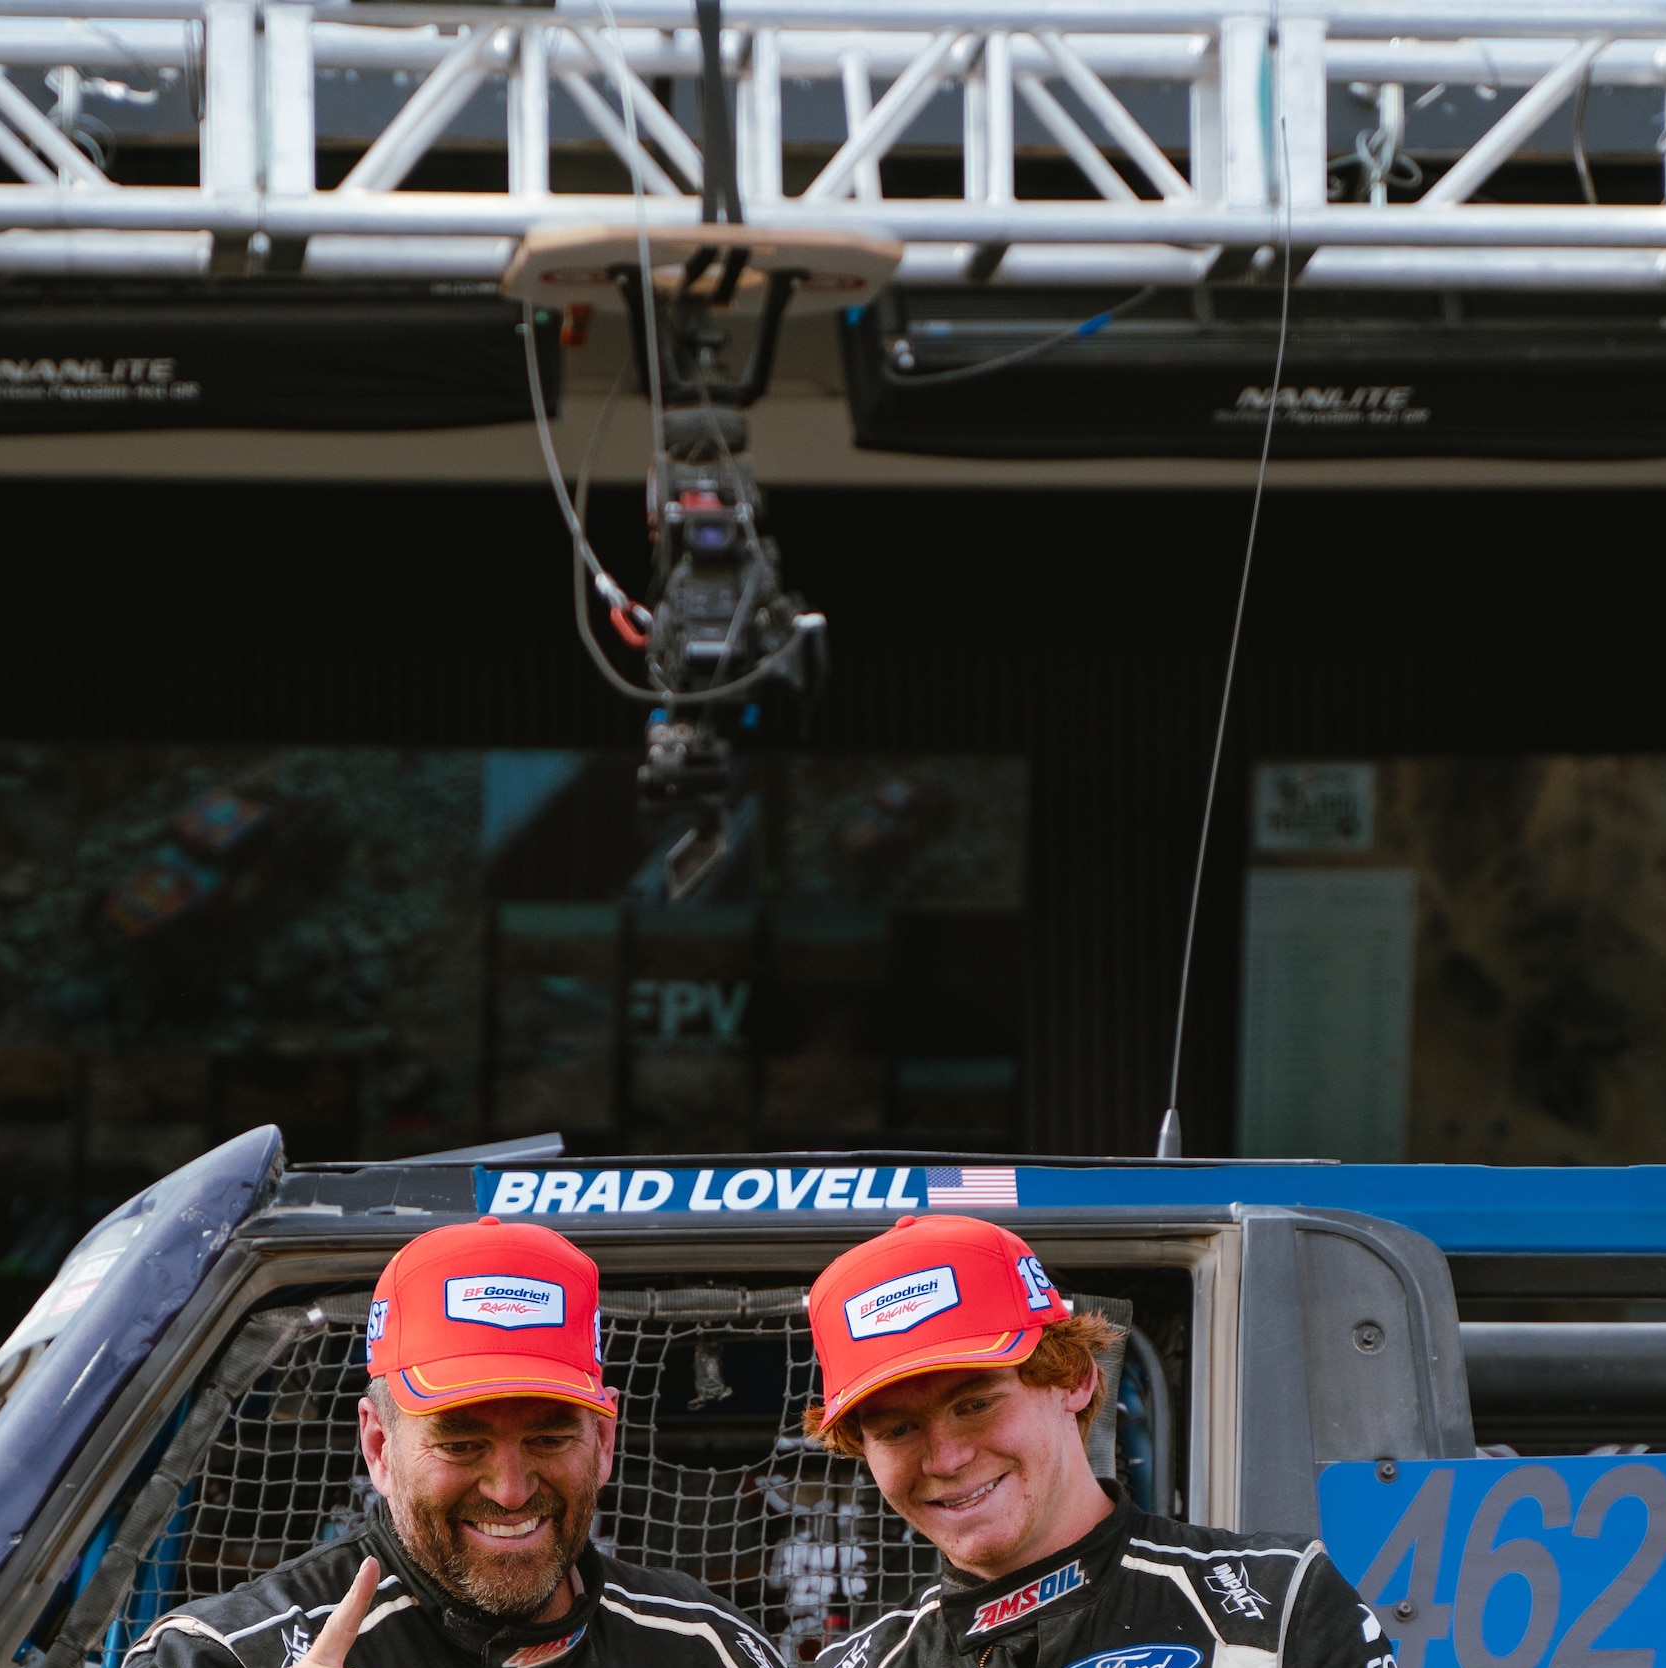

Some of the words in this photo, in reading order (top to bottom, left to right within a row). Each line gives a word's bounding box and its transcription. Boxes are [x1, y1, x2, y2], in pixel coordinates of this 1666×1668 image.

[1235, 386, 1416, 409] NANLITE
[488, 1170, 673, 1214] BRAD
[688, 1167, 920, 1210] LOVELL
[463, 1286, 550, 1302] BFGoodrich
[860, 1279, 938, 1315] BFGoodrich
[1017, 1255, 1056, 1311] 1S
[477, 1302, 541, 1315] RACING
[875, 1299, 933, 1326] RACING
[967, 1560, 1083, 1634] AMSOIL
[1213, 1563, 1265, 1621] IMPACT
[292, 1625, 309, 1668] ACT
